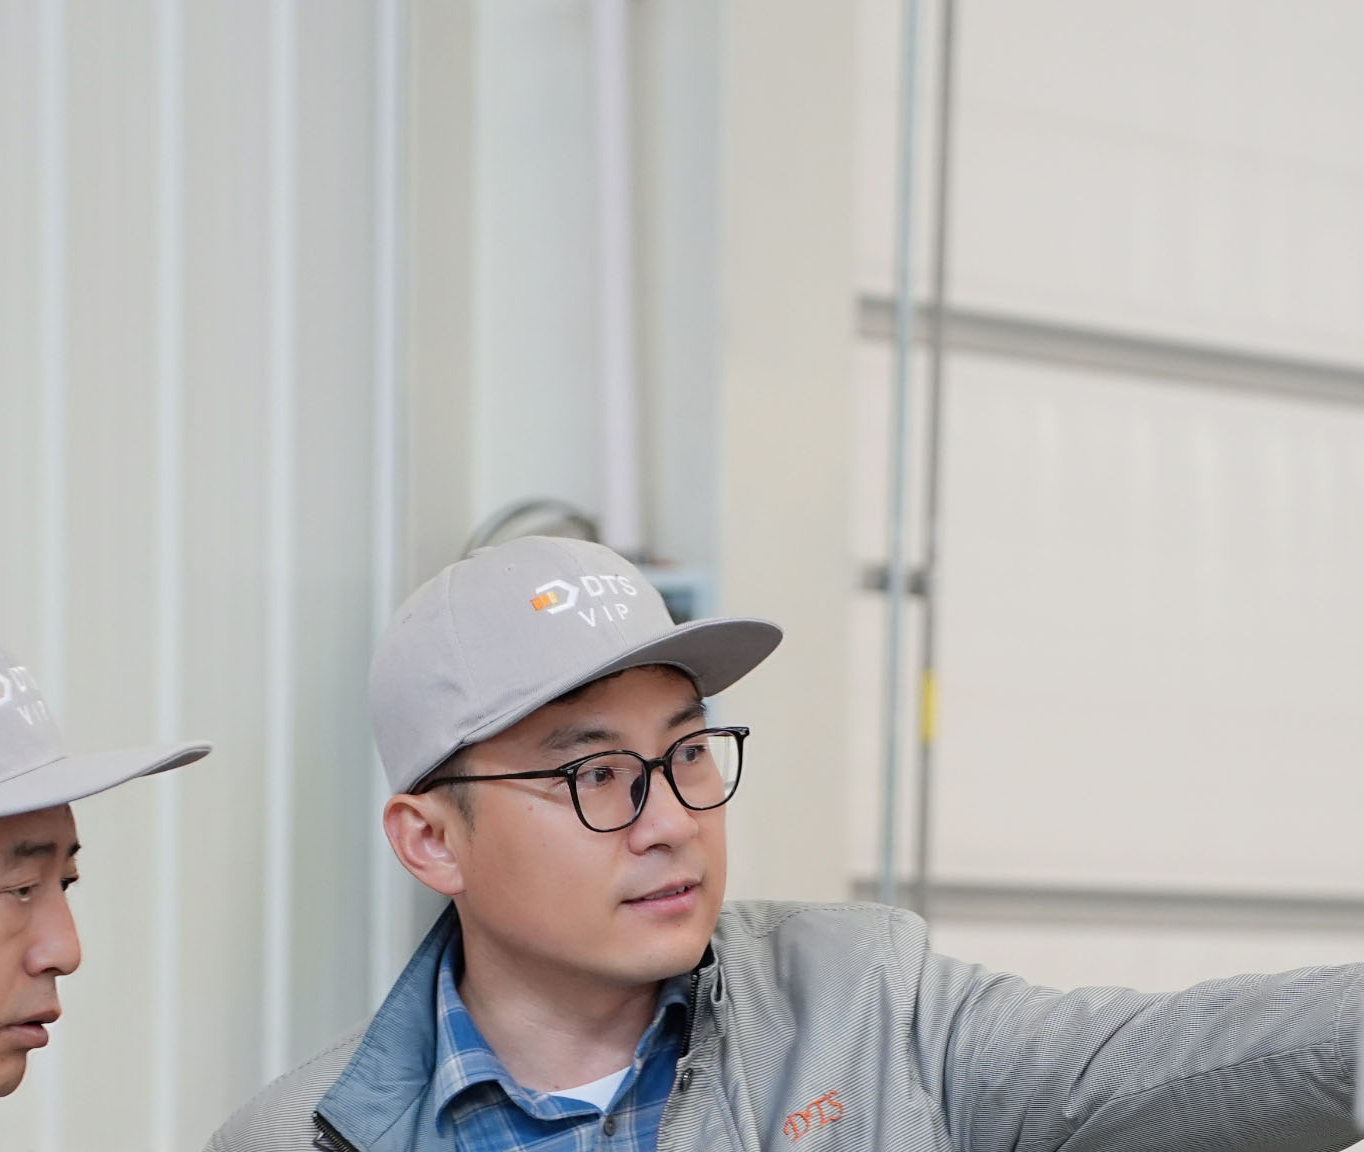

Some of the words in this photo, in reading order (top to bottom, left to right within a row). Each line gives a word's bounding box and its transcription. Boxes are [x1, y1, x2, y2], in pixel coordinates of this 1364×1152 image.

[579, 575, 638, 597] DTS
[577, 603, 629, 627] VIP
[783, 1089, 844, 1143] DTS
